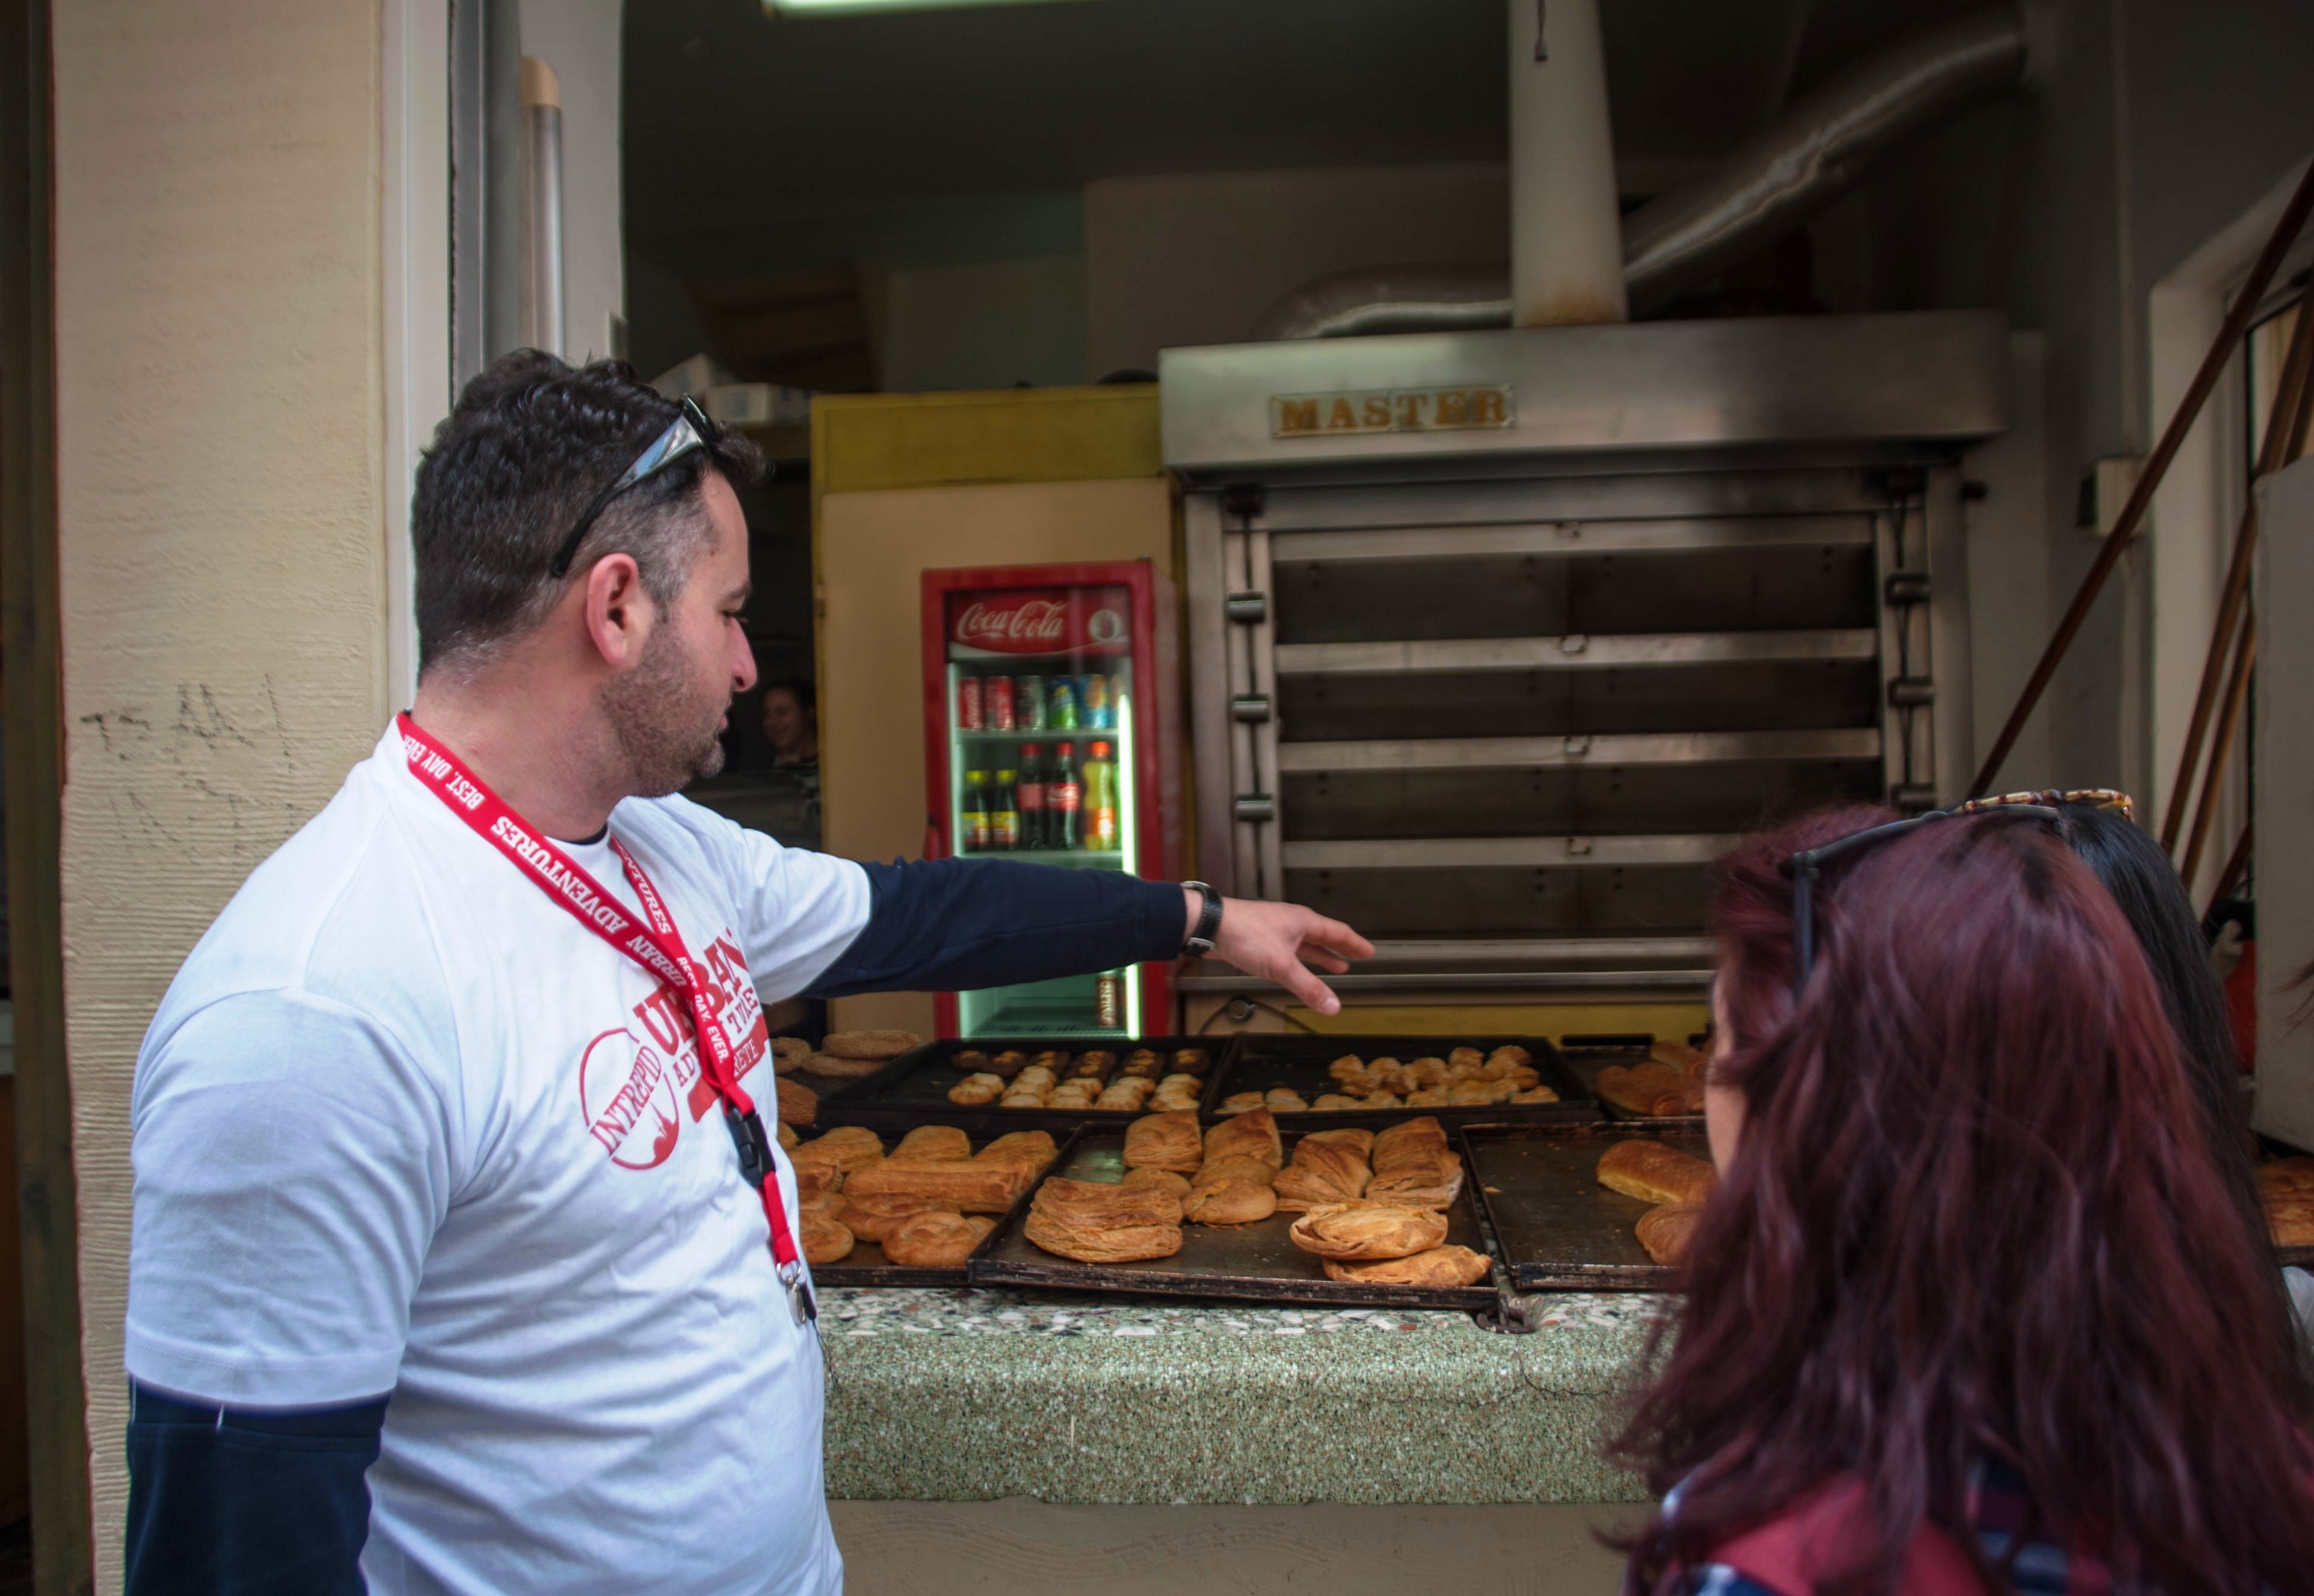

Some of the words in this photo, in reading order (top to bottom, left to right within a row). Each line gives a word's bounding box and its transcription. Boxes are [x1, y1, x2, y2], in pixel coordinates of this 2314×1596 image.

[1279, 389, 1508, 432] MASTER
[956, 601, 1069, 639] Coca-Cola
[420, 750, 452, 780] DAY.
[445, 771, 485, 809] BEST.
[490, 815, 630, 933] ADVENTURES
[625, 935, 688, 986] URBAN
[733, 1038, 759, 1075] RETE
[589, 1045, 662, 1156] INTREPID
